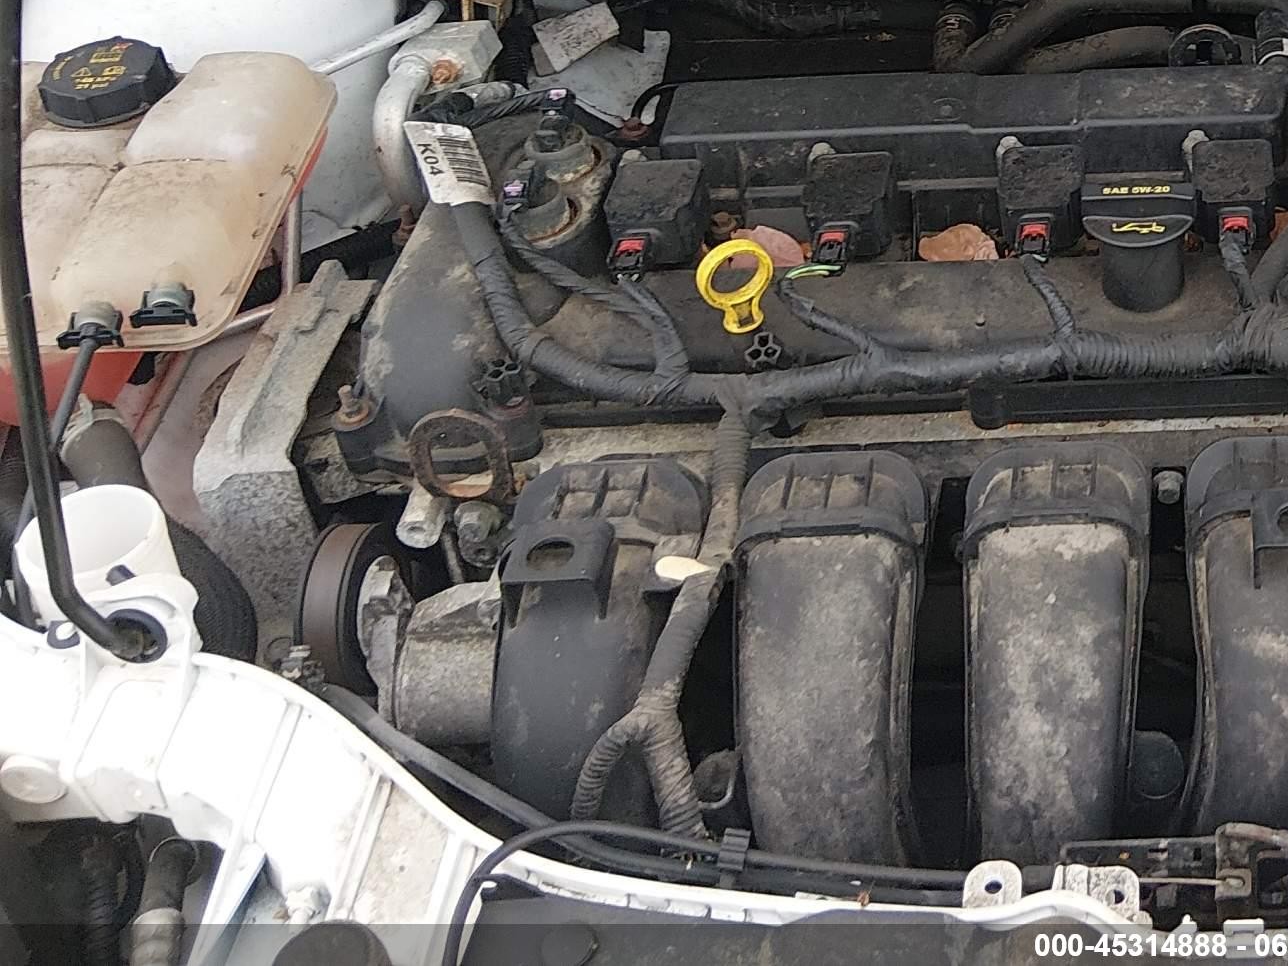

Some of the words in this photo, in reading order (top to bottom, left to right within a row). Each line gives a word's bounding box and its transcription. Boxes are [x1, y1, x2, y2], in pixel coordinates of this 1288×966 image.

[417, 143, 445, 176] K04
[1102, 186, 1129, 195] SAE
[1131, 185, 1171, 194] 5W-20
